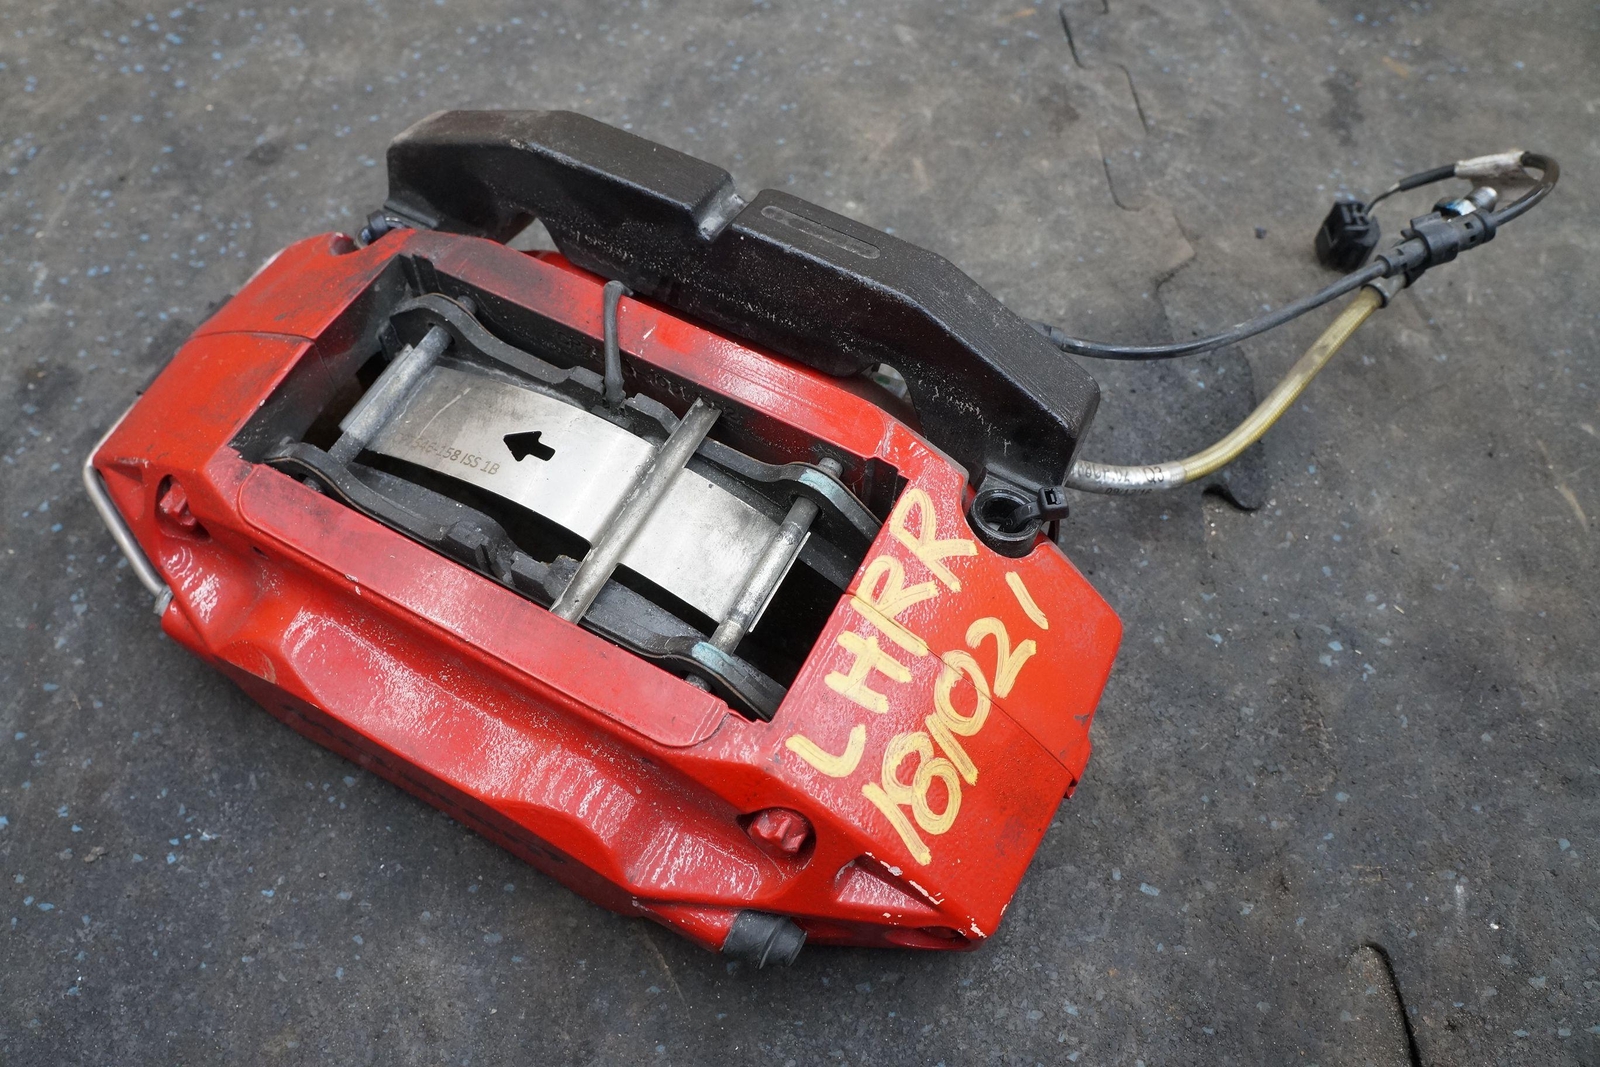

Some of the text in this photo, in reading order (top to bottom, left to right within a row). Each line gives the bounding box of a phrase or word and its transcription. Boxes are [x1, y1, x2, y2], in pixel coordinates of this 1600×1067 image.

[459, 453, 482, 468] ISS
[480, 460, 500, 475] 1B
[785, 488, 978, 778] LHRR
